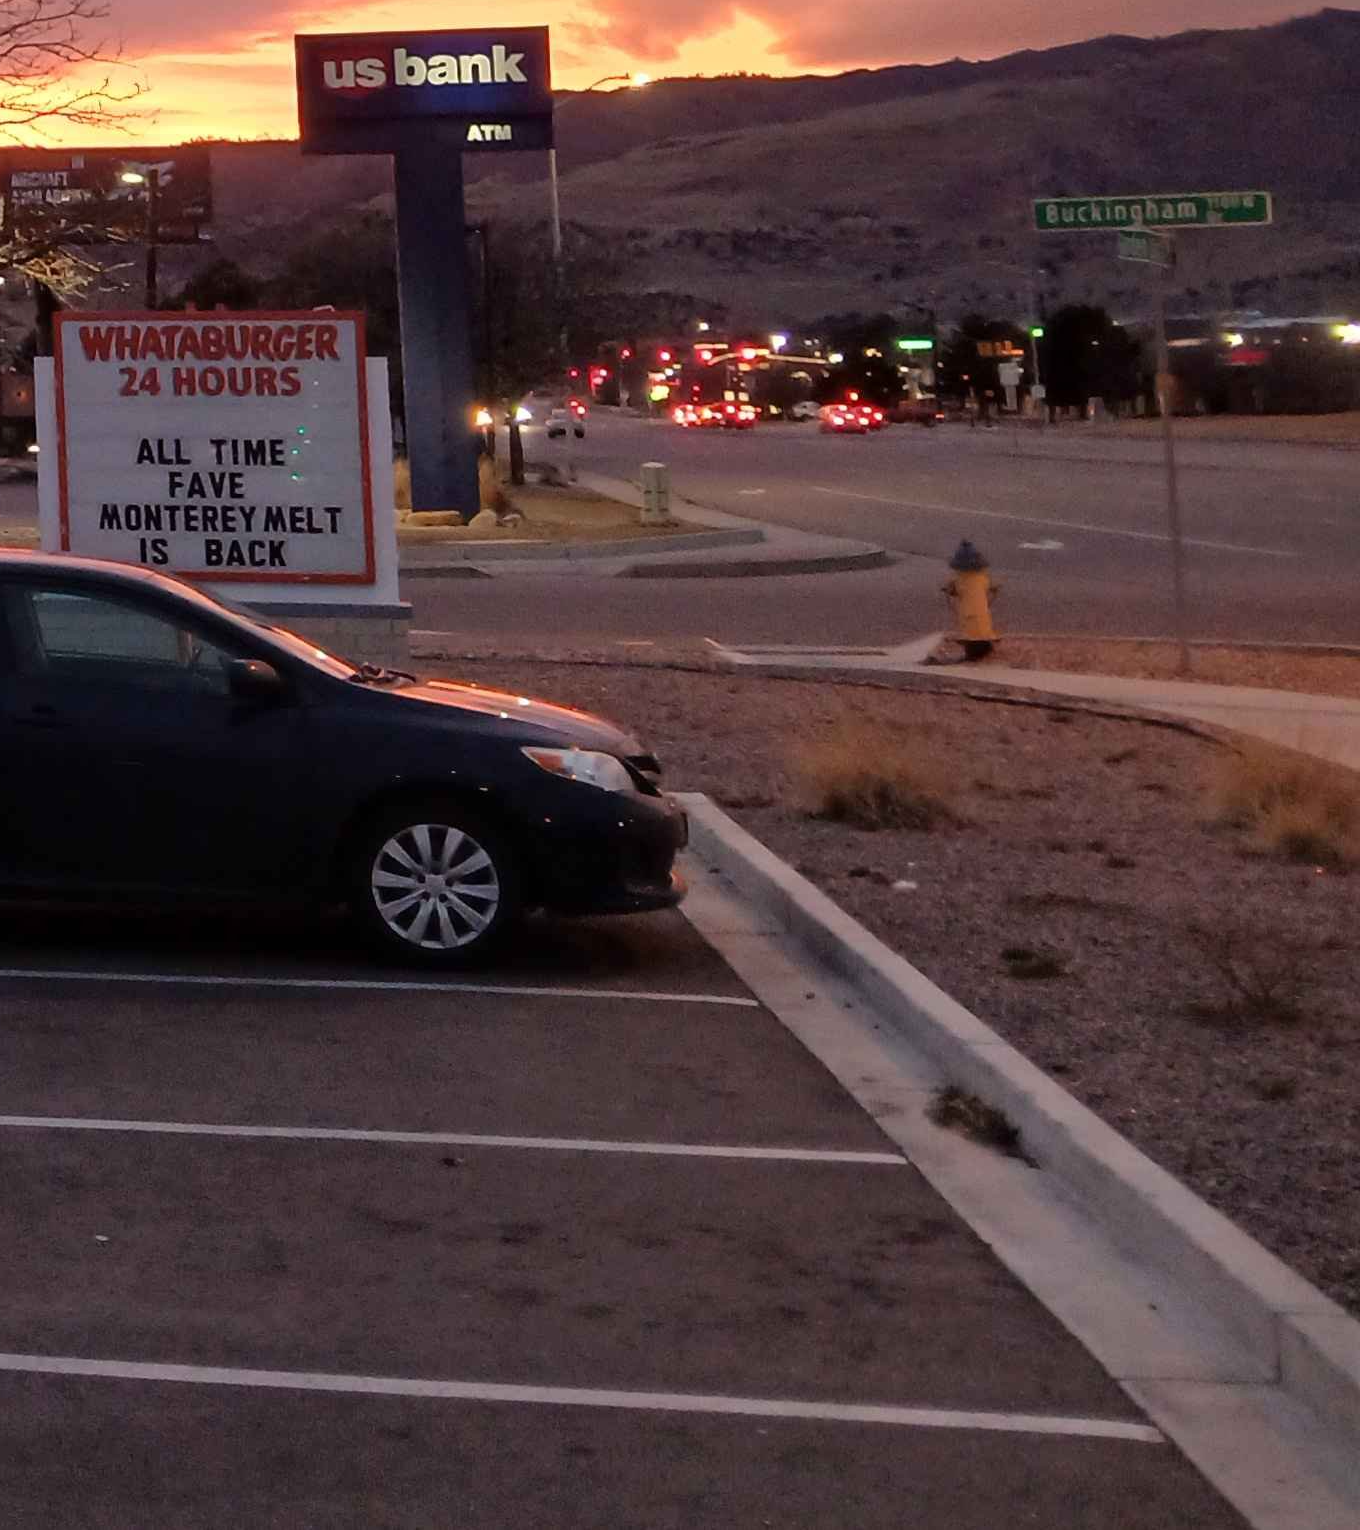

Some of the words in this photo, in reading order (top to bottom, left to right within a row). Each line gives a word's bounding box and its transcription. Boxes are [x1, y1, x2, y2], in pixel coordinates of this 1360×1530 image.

[323, 57, 387, 88] us
[393, 44, 528, 86] bank
[467, 124, 512, 141] ATM
[1046, 199, 1197, 224] Buckingham
[79, 324, 340, 361] WHATABURGER
[119, 368, 160, 396] 24
[173, 367, 302, 396] HOURS
[137, 438, 191, 466] ALL
[210, 439, 285, 466] TIME
[168, 472, 244, 499] FAVE
[99, 504, 256, 533] MONTEREY
[263, 506, 343, 534] MELT
[140, 538, 169, 565] IS
[205, 539, 287, 567] BACK
